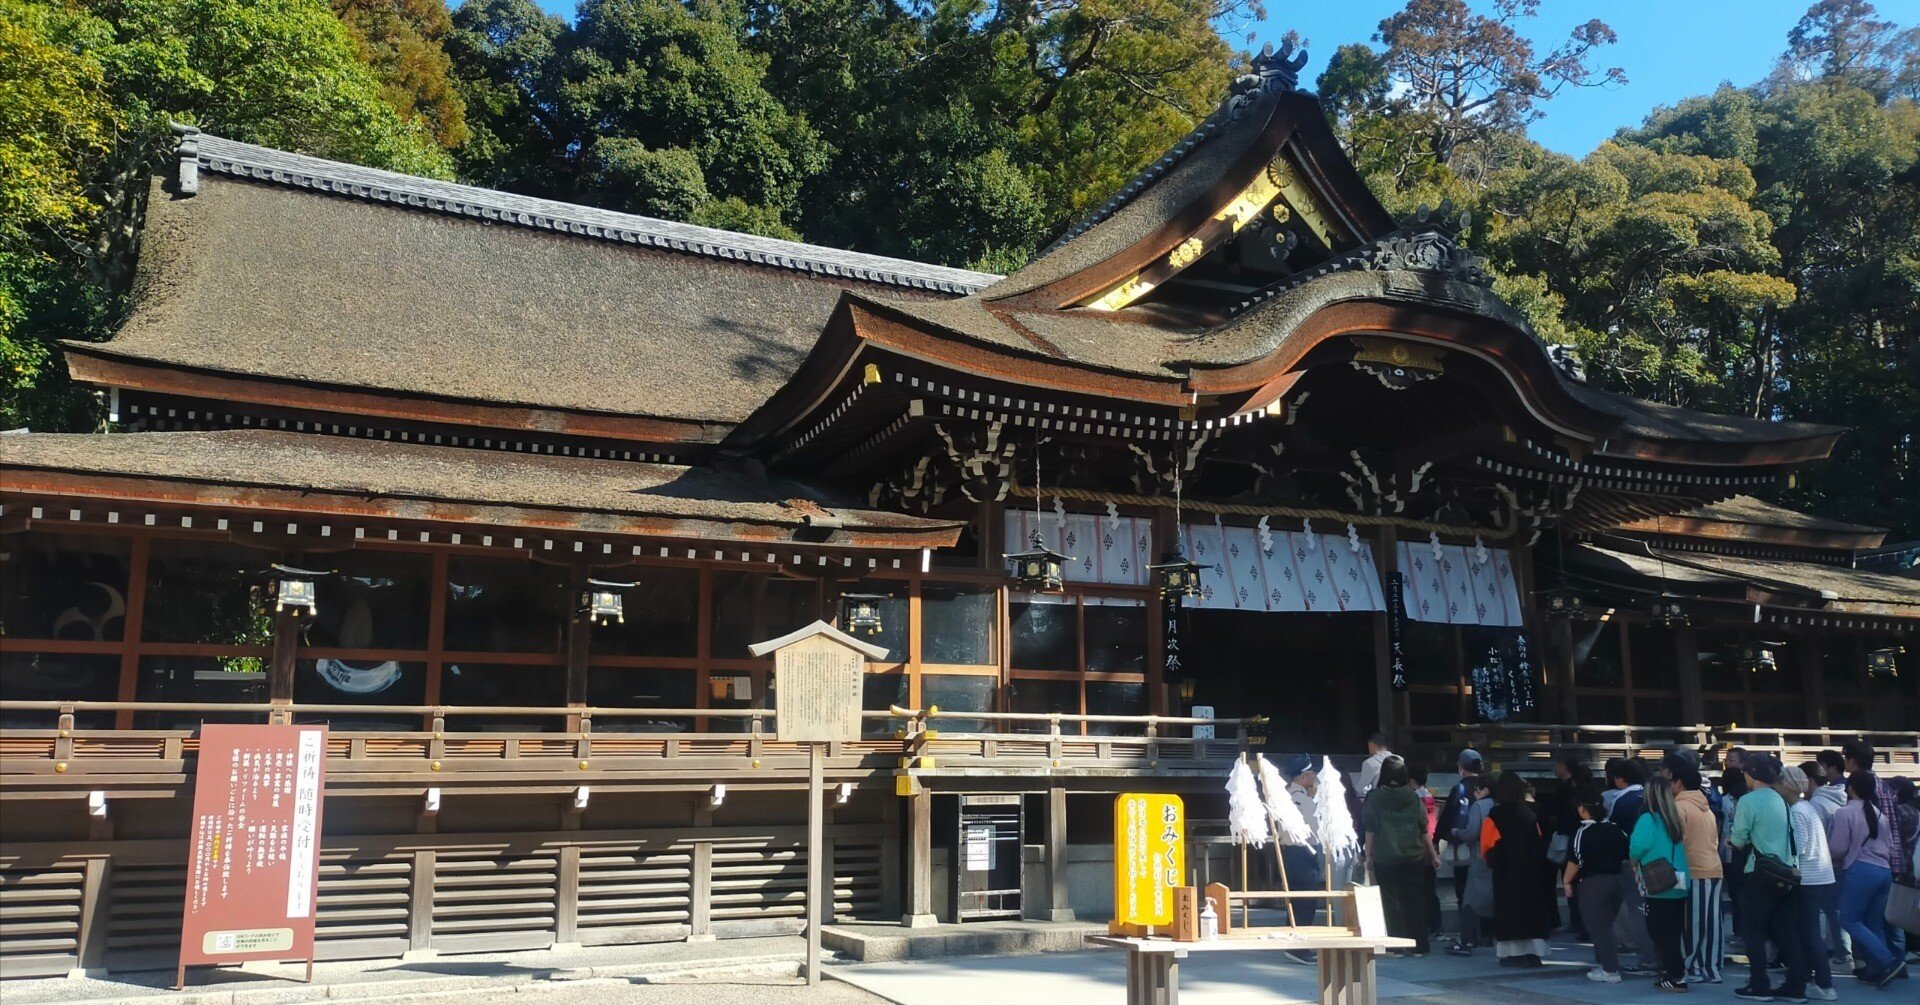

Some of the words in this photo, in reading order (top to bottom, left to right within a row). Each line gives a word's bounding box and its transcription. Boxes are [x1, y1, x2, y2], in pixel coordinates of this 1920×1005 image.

[1166, 619, 1181, 671] 月次祭
[1392, 641, 1406, 688] 天長祭
[1161, 804, 1178, 886] おみくじ
[1182, 894, 1190, 933] おみくじ
